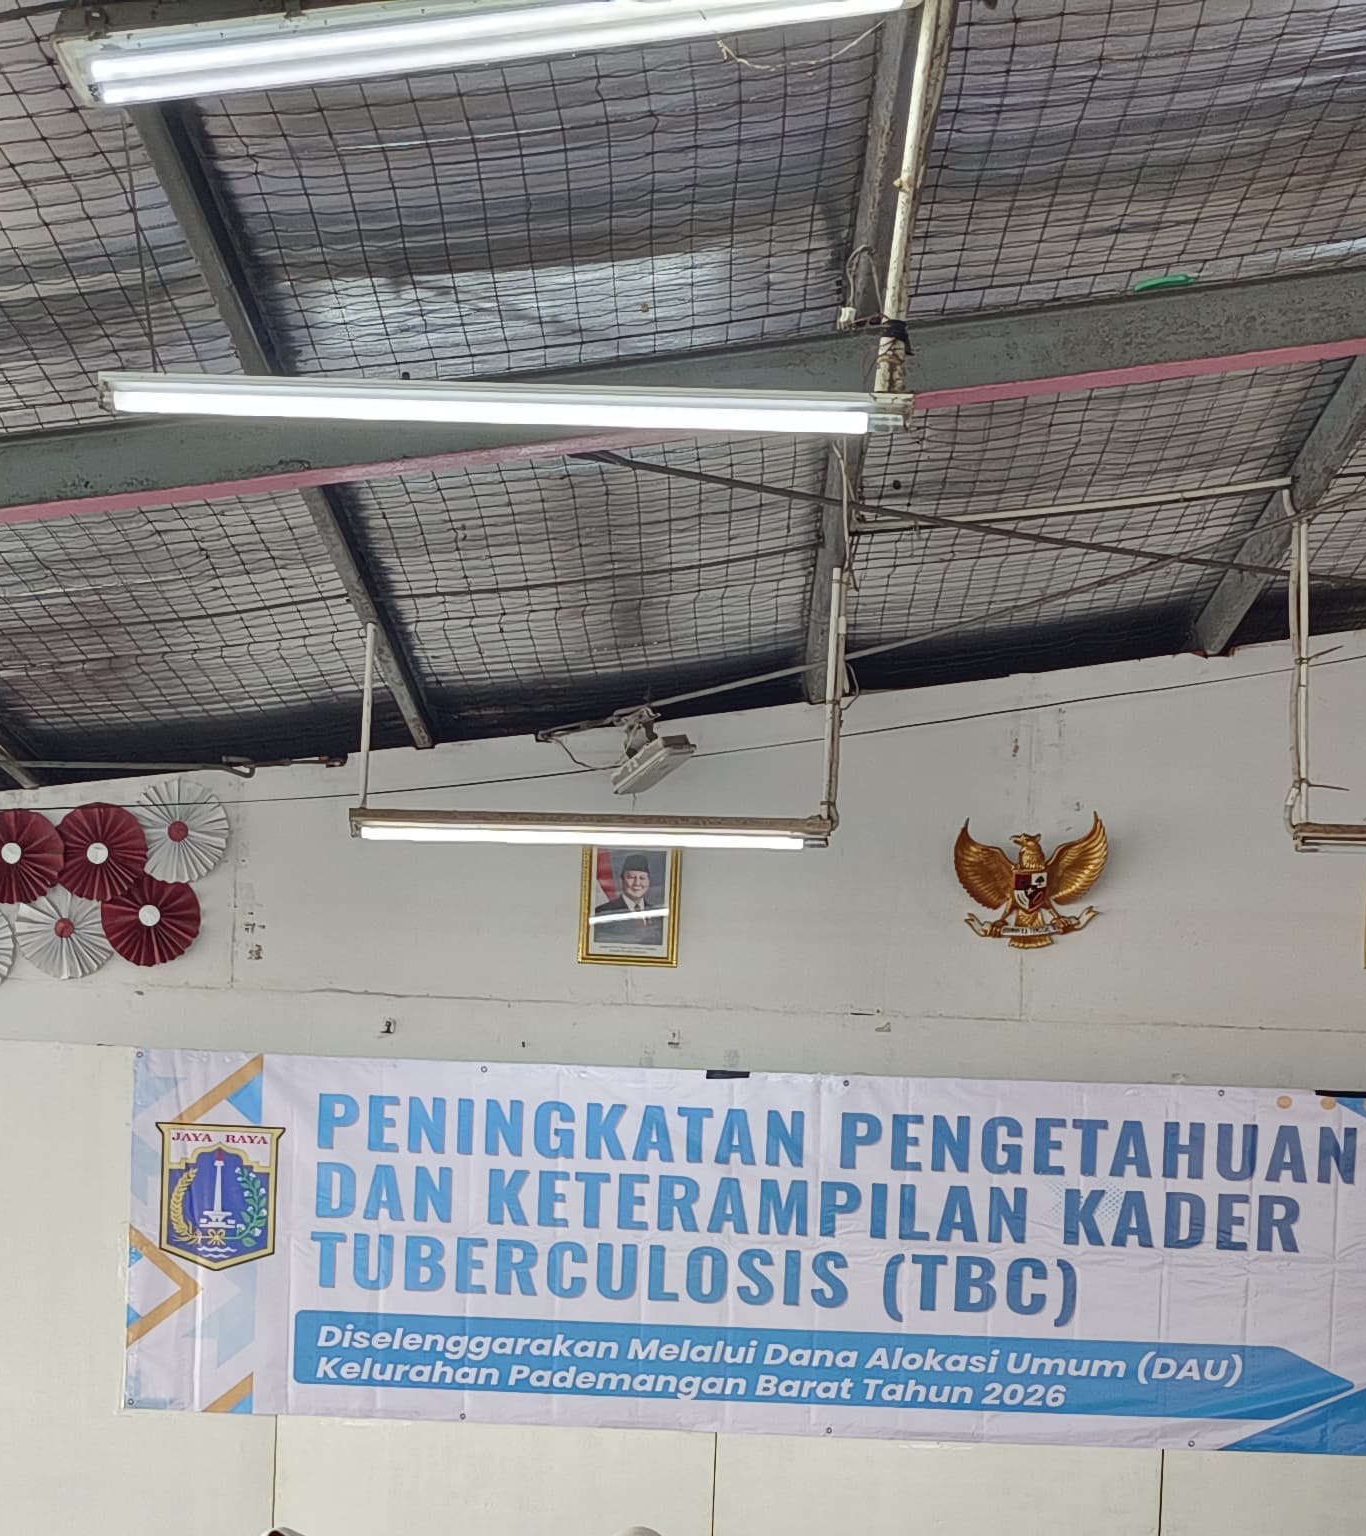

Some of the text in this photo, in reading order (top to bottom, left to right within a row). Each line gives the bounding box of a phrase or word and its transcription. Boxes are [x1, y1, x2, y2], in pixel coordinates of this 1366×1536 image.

[172, 1132, 268, 1145] JAYA RAYA
[317, 1092, 1358, 1185] PENINGKATAN PENGETAHUAN
[315, 1163, 1301, 1253] DAN KETERAMPILAN KADER
[310, 1230, 1078, 1327] TUBERCULOSIS (TBC)
[316, 1356, 1067, 1408] Kelurahan Pademangan Barat Tahun 2026
[317, 1324, 1244, 1387] Diselenggarakan Melalui Dana Alokasi Umum (DAU)
